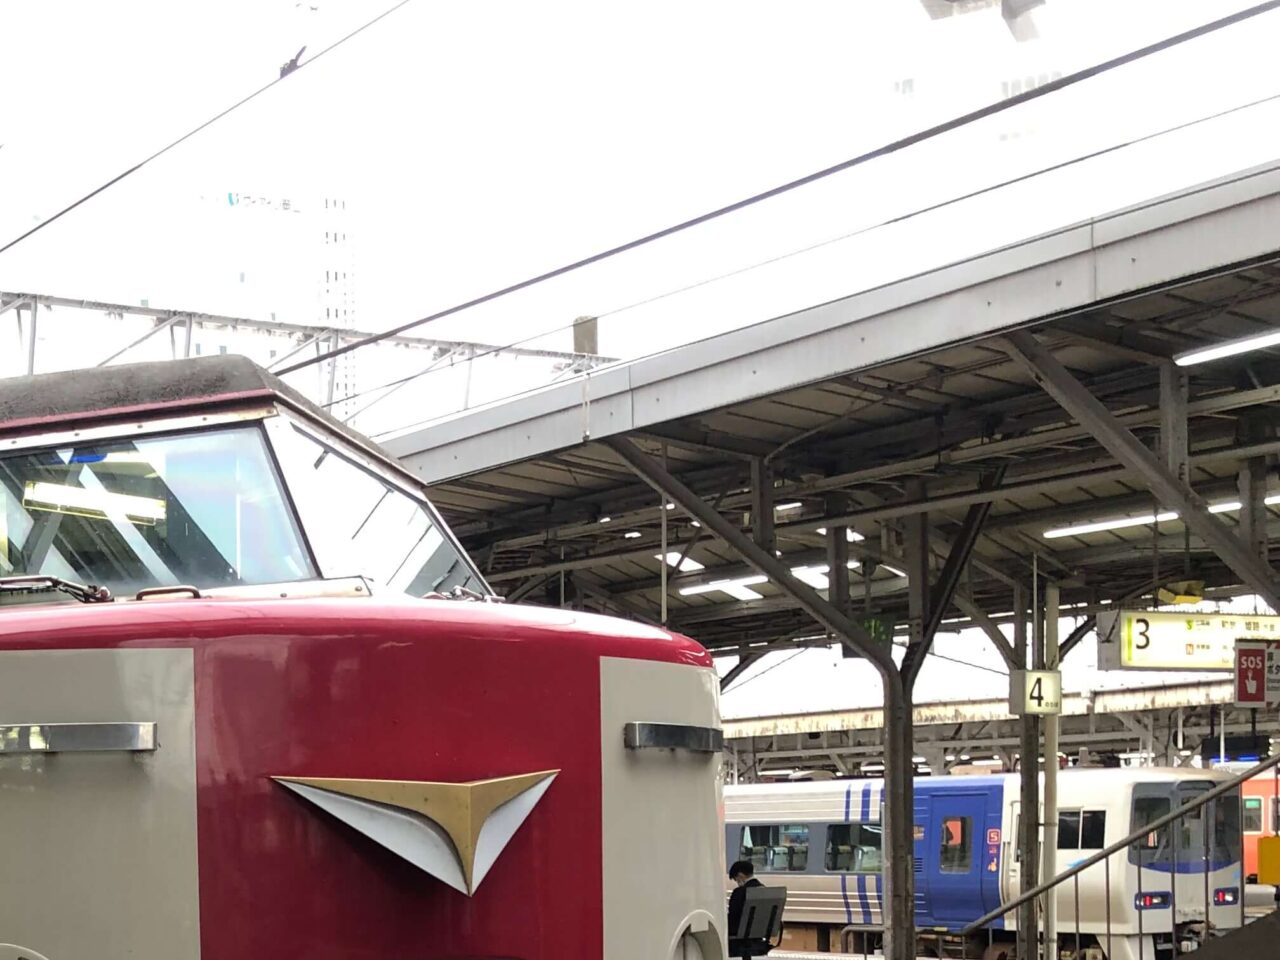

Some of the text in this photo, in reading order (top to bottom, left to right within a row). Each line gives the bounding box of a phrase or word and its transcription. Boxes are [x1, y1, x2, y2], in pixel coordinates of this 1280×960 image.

[1135, 618, 1150, 650] 3
[1241, 656, 1262, 669] SOS
[1029, 677, 1044, 707] 4
